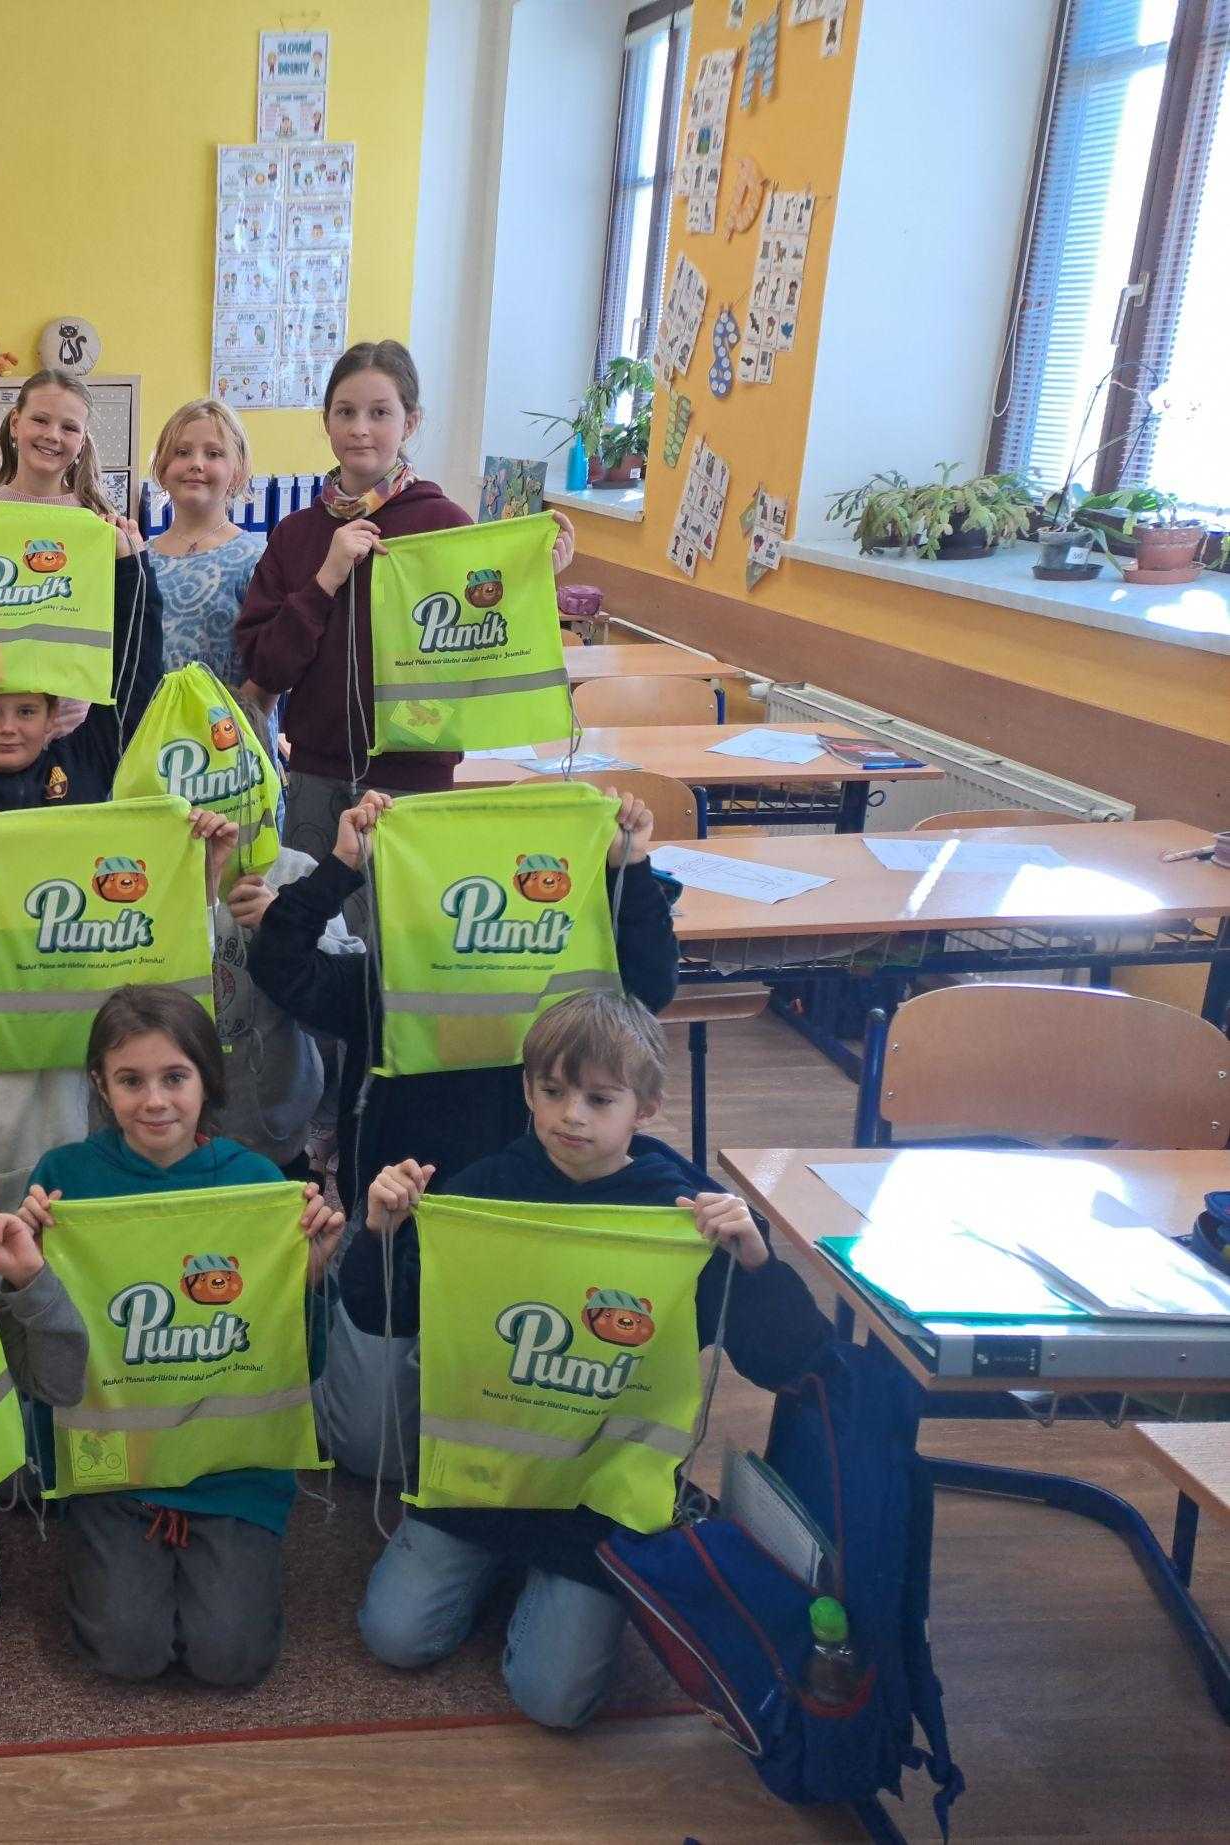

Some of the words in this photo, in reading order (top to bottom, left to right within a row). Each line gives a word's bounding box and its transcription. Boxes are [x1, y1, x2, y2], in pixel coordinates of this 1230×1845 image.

[411, 591, 508, 653] Pumík
[24, 878, 154, 954] Pumík
[108, 1281, 250, 1365] Pumík
